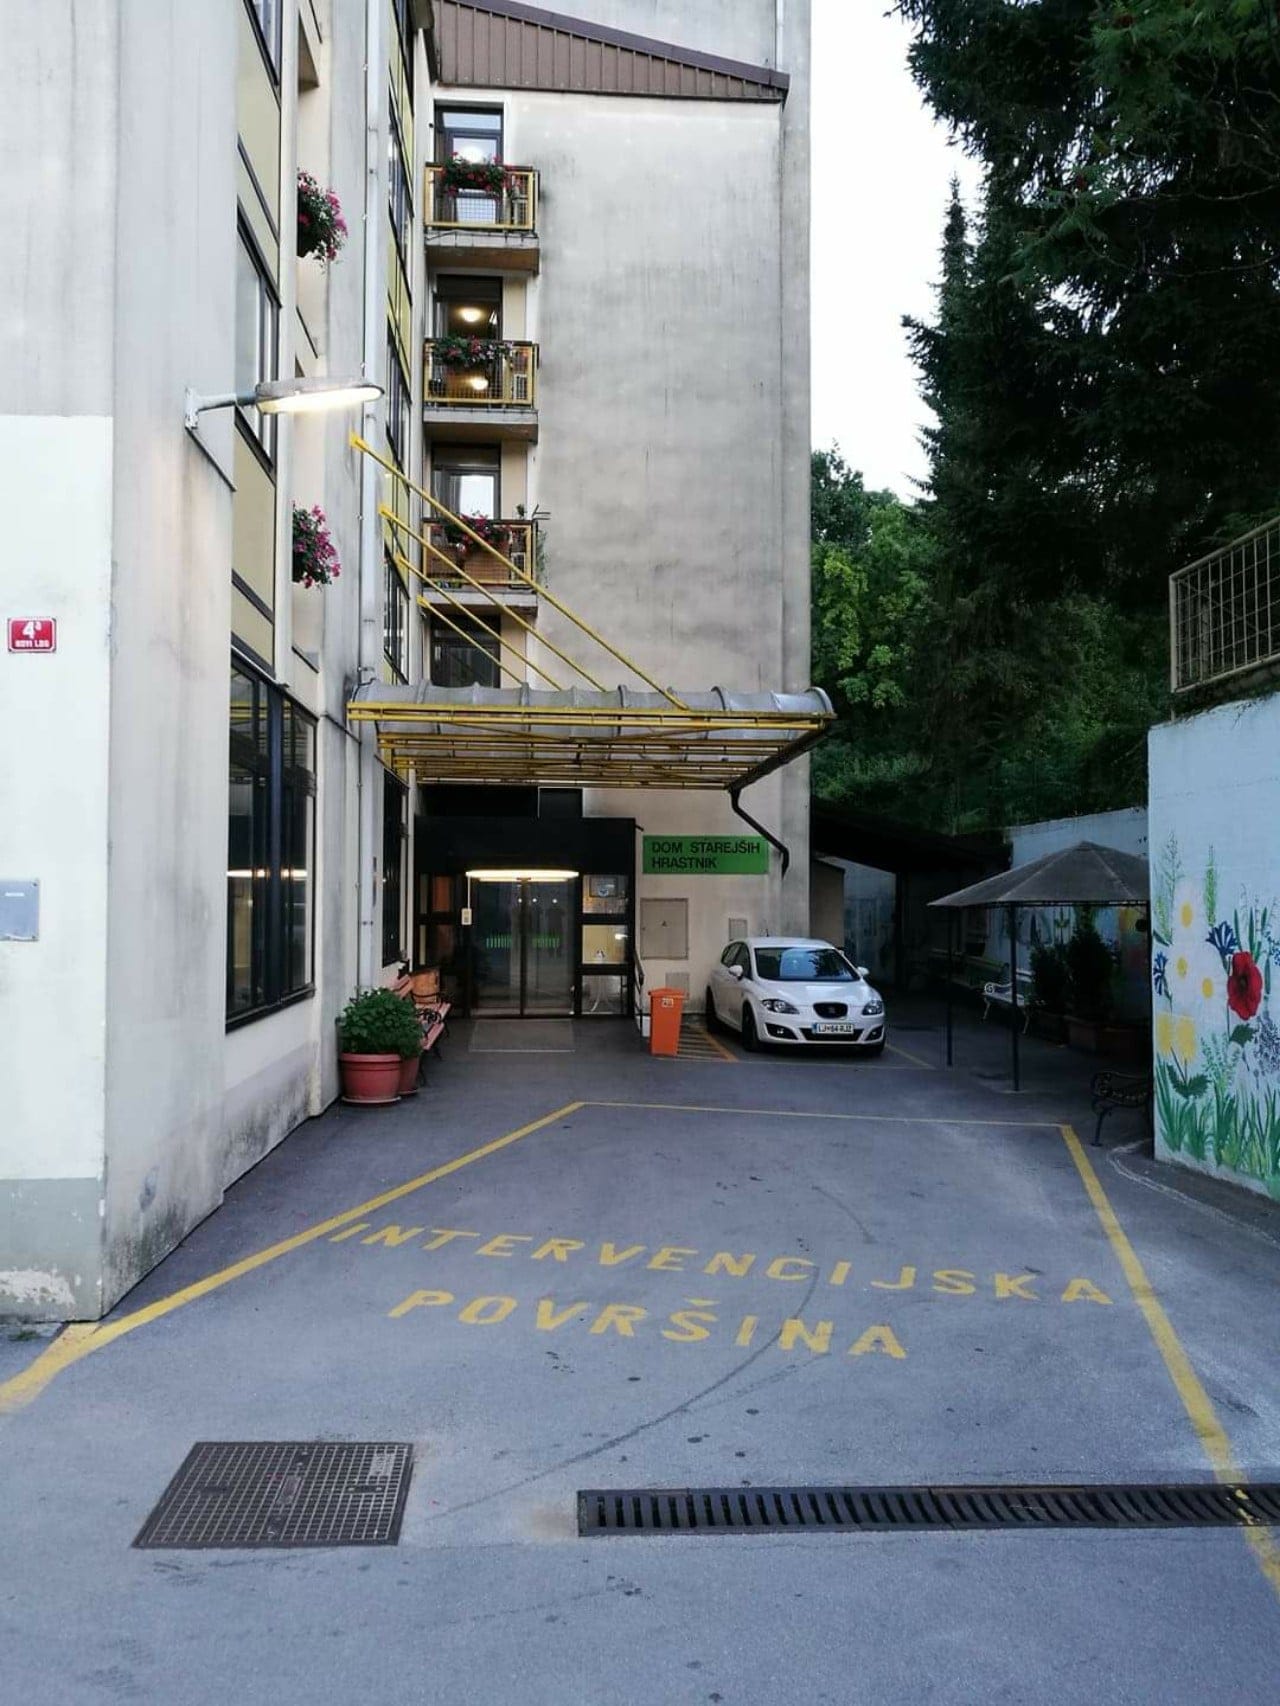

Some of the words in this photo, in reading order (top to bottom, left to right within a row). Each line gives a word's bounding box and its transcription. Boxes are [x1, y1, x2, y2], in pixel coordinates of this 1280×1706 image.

[652, 841, 683, 854] DOM
[690, 840, 760, 854] STAREJŠIH
[652, 857, 717, 869] HRASTNIK
[330, 1223, 1112, 1307] INTERVENCIJSKA
[388, 1290, 908, 1360] POVRŠINA
